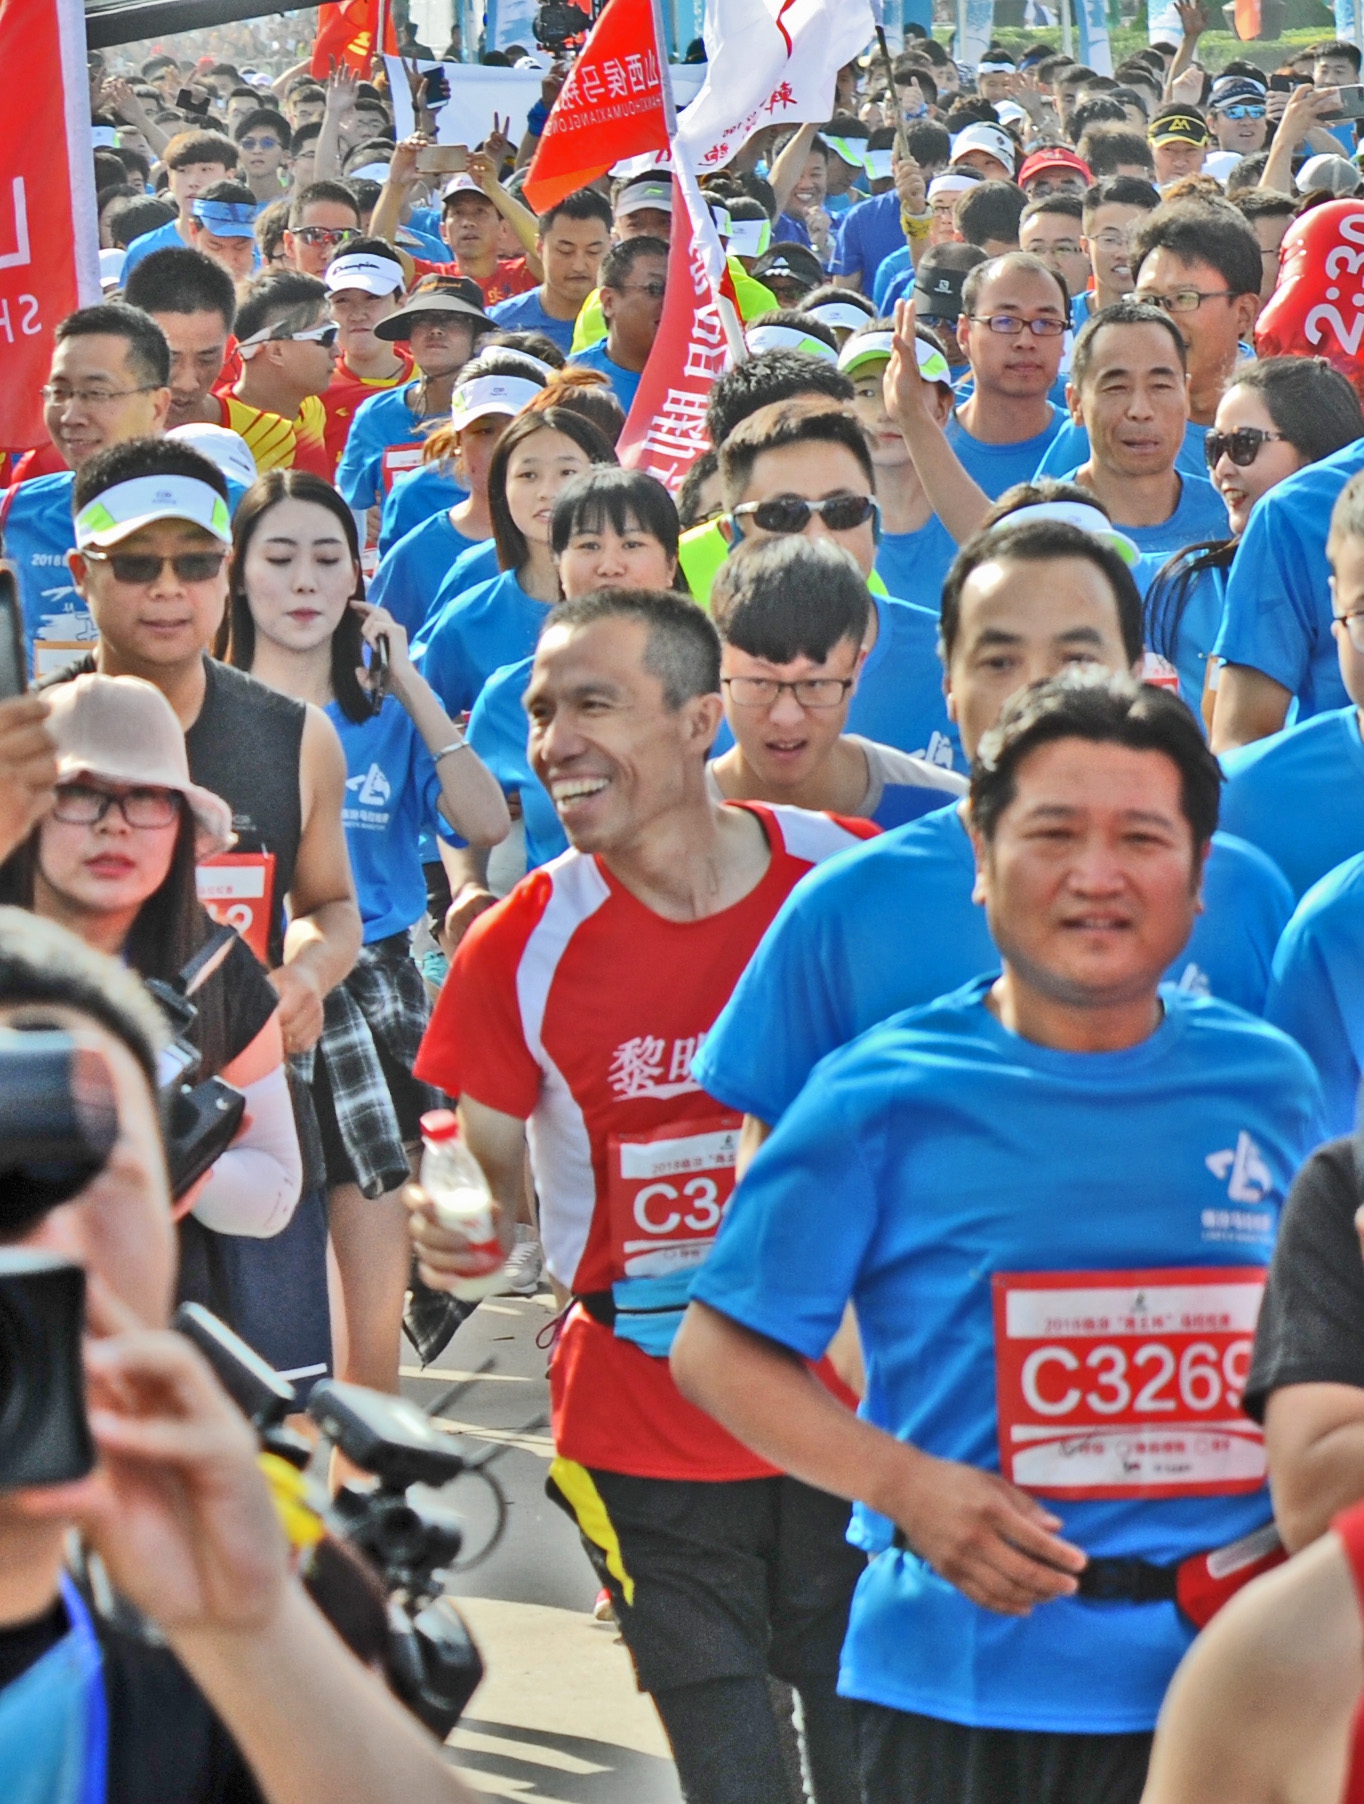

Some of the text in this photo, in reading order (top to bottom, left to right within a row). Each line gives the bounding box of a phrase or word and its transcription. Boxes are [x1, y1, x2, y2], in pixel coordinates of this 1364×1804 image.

[31, 553, 67, 567] 2018
[633, 1176, 730, 1235] C3
[1020, 1338, 1254, 1417] C3269
